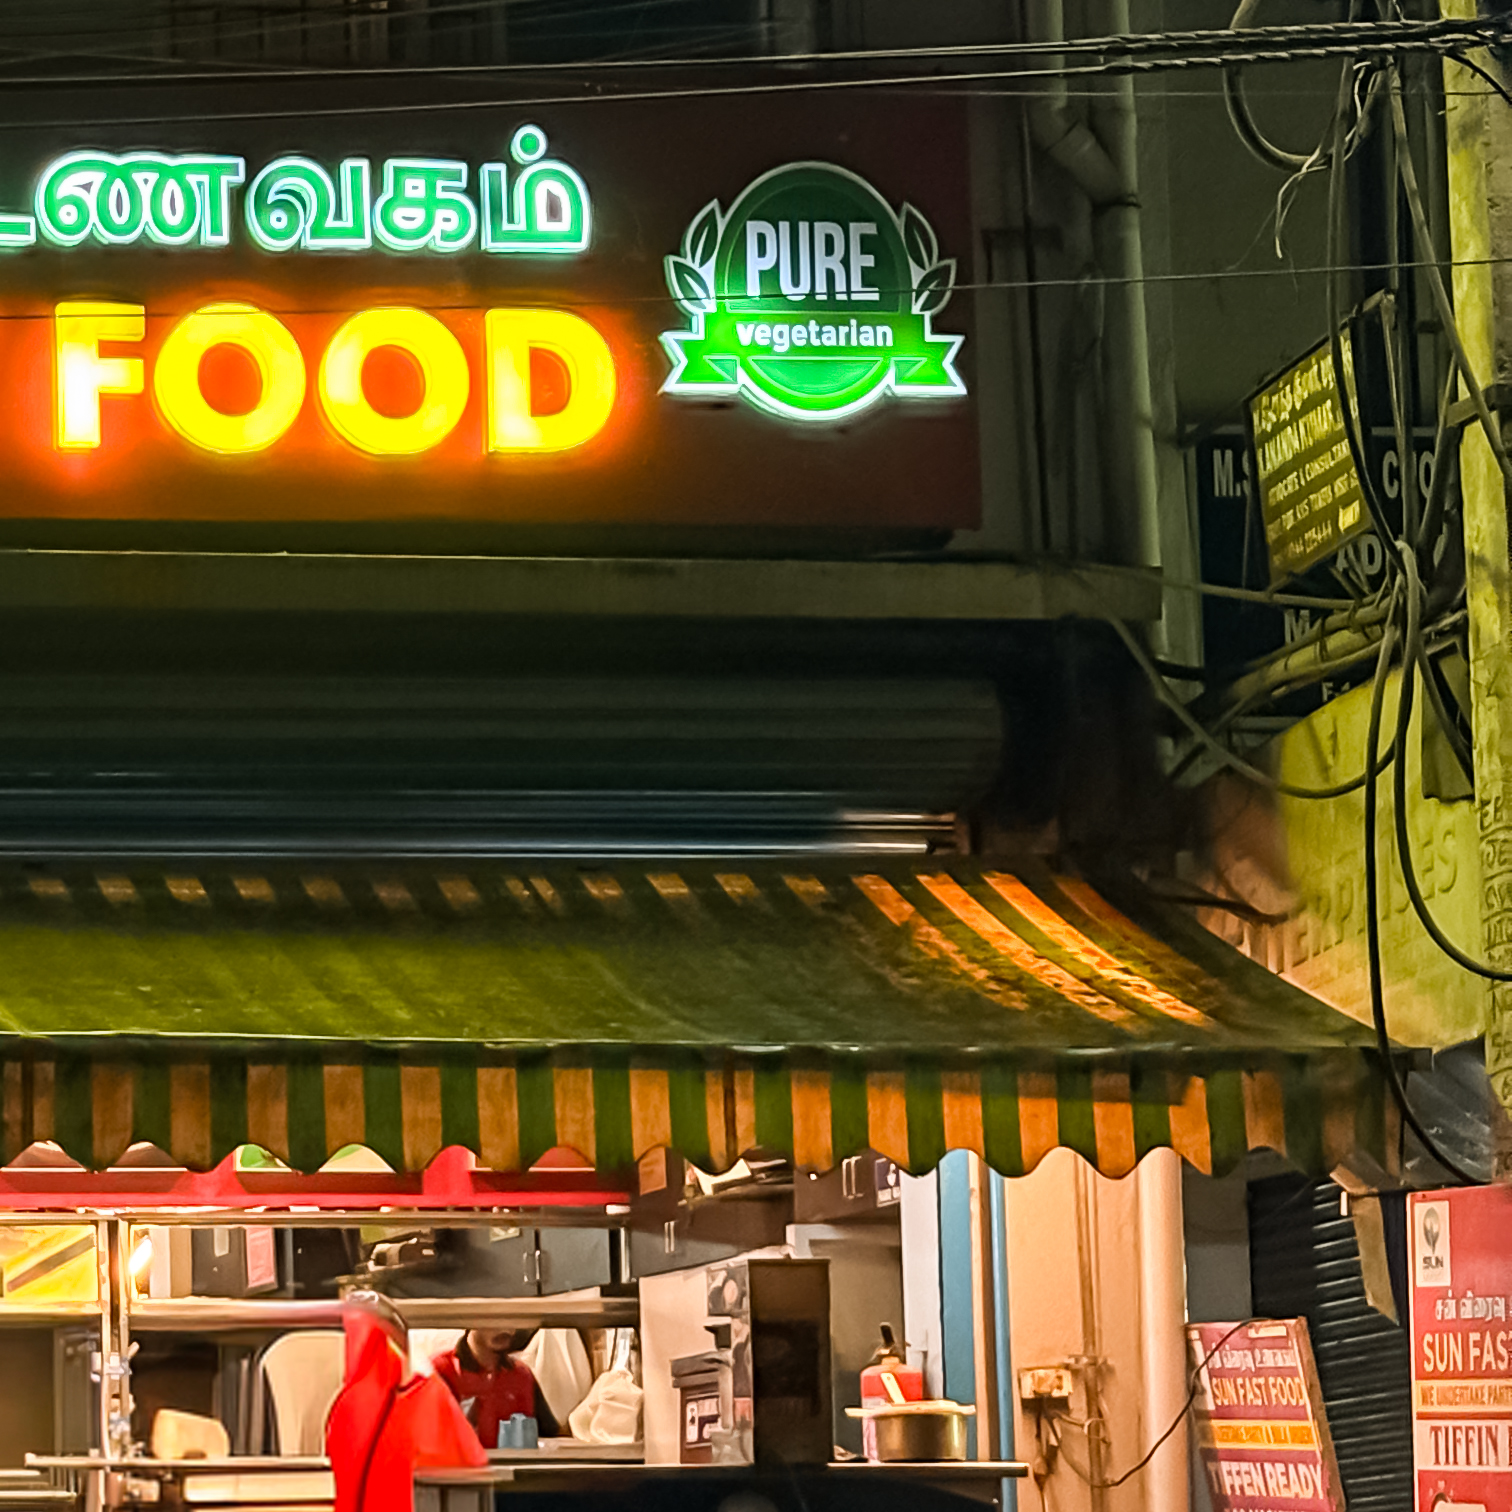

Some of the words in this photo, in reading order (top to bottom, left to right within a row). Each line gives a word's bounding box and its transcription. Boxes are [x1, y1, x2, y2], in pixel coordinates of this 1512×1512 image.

[746, 220, 880, 301] PURE
[735, 318, 894, 353] vegetarian
[54, 301, 617, 454] FOOD
[1423, 1332, 1464, 1372] SUN
[1211, 1376, 1238, 1406] SUN
[1236, 1376, 1268, 1406] FAST
[1268, 1376, 1306, 1406] FOOD
[1429, 1424, 1500, 1466] TIFFIN
[1263, 1462, 1324, 1499] READY
